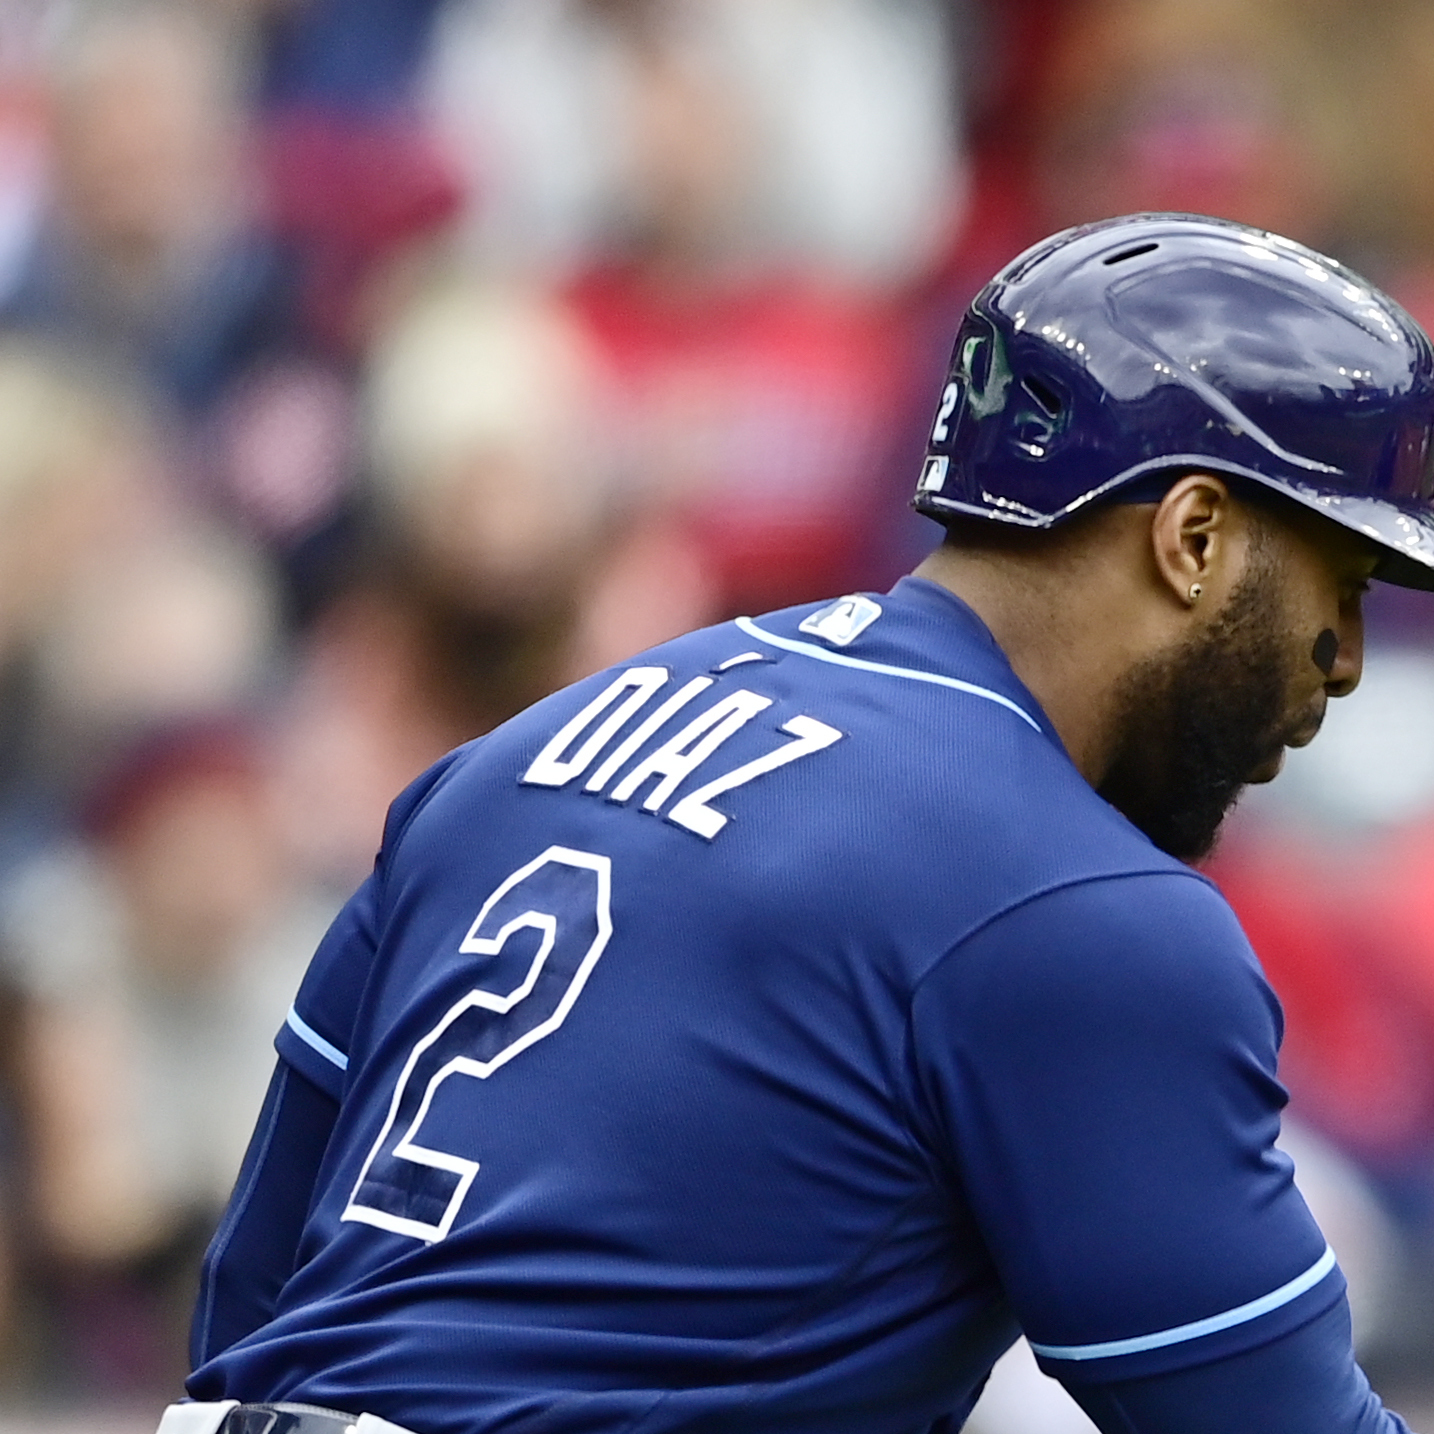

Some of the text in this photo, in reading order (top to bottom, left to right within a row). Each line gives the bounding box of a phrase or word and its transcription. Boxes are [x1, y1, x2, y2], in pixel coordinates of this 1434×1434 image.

[932, 382, 958, 442] 2
[518, 651, 844, 840] DÍAZ
[340, 845, 613, 1244] 2
